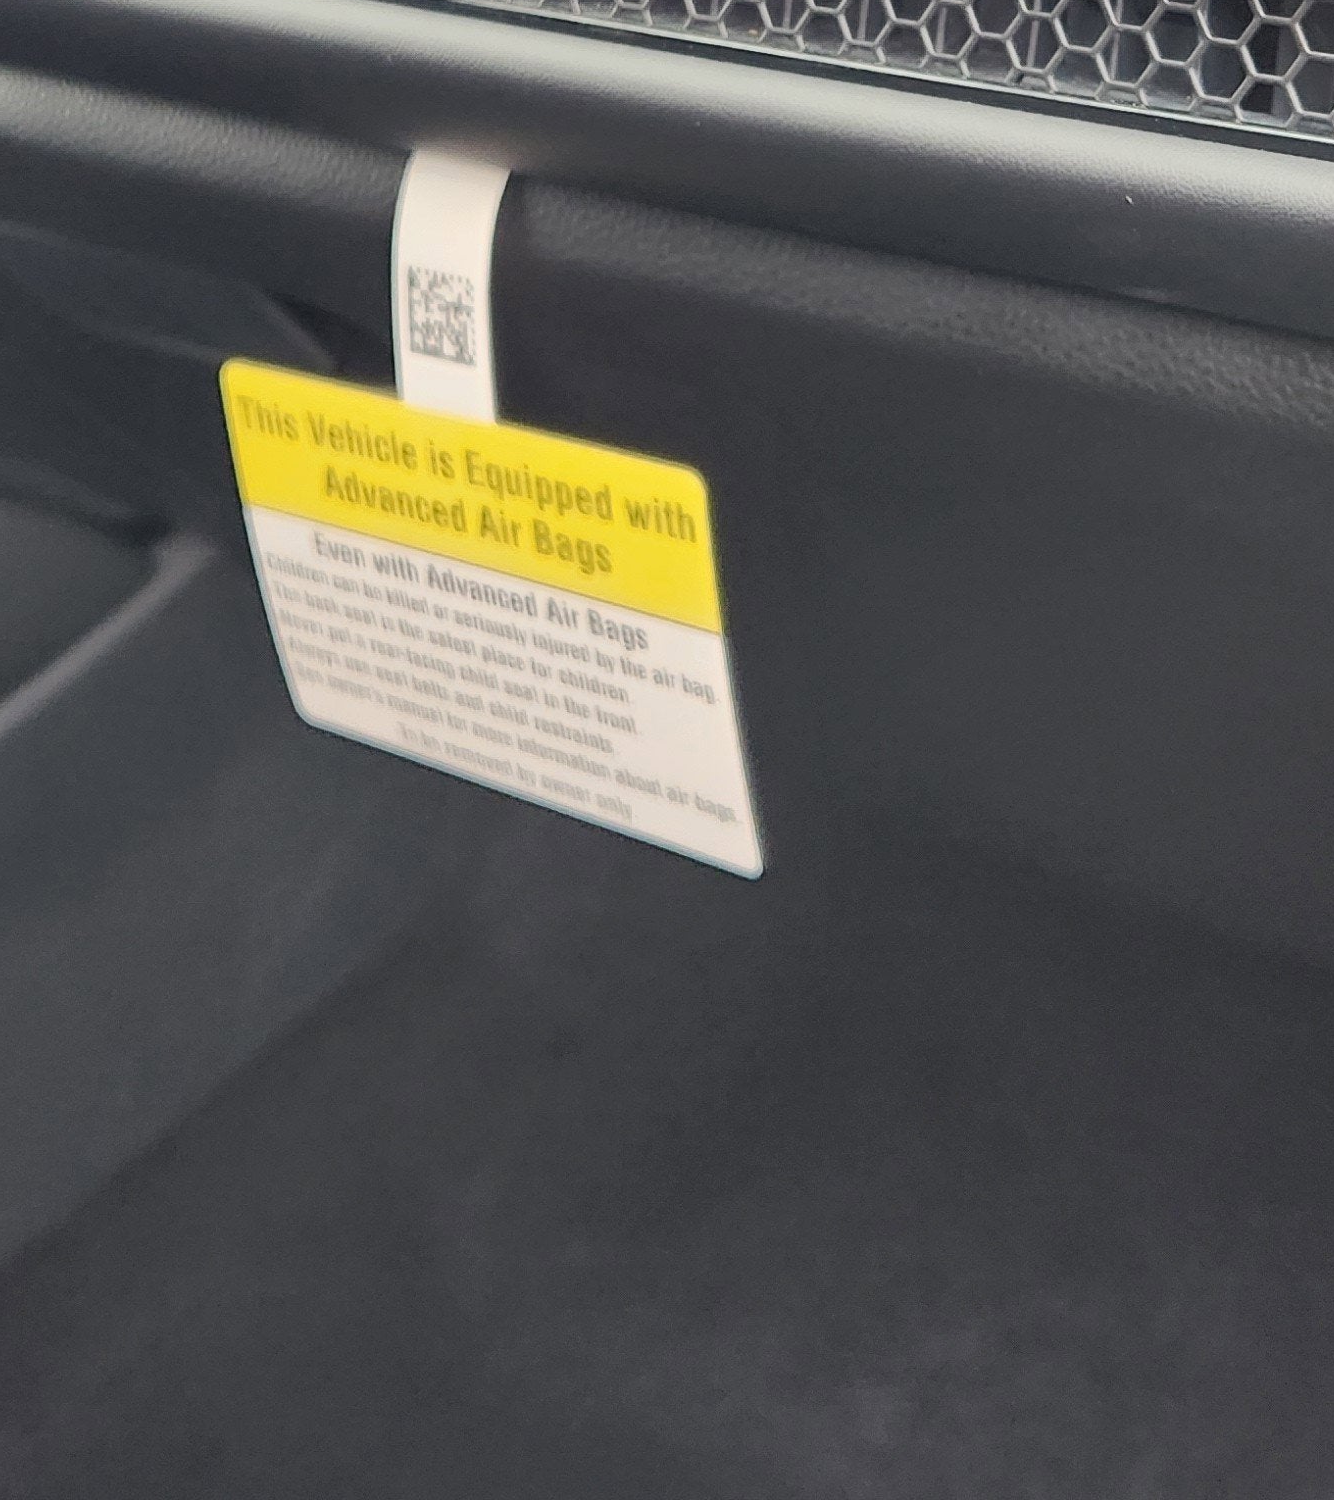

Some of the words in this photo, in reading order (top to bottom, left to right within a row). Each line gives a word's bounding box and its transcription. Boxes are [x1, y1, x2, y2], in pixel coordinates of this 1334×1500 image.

[240, 396, 299, 440] This
[306, 410, 417, 470] Vehicle
[427, 438, 455, 479] is
[463, 448, 613, 523] Equipped
[624, 495, 694, 542] with
[322, 464, 467, 532] Advanced
[478, 504, 522, 547] Air
[532, 518, 613, 576] Bags
[313, 531, 365, 567] Even
[371, 551, 419, 583] with
[426, 563, 537, 617] Advanced
[545, 596, 578, 628] Air
[587, 608, 649, 652] Bags
